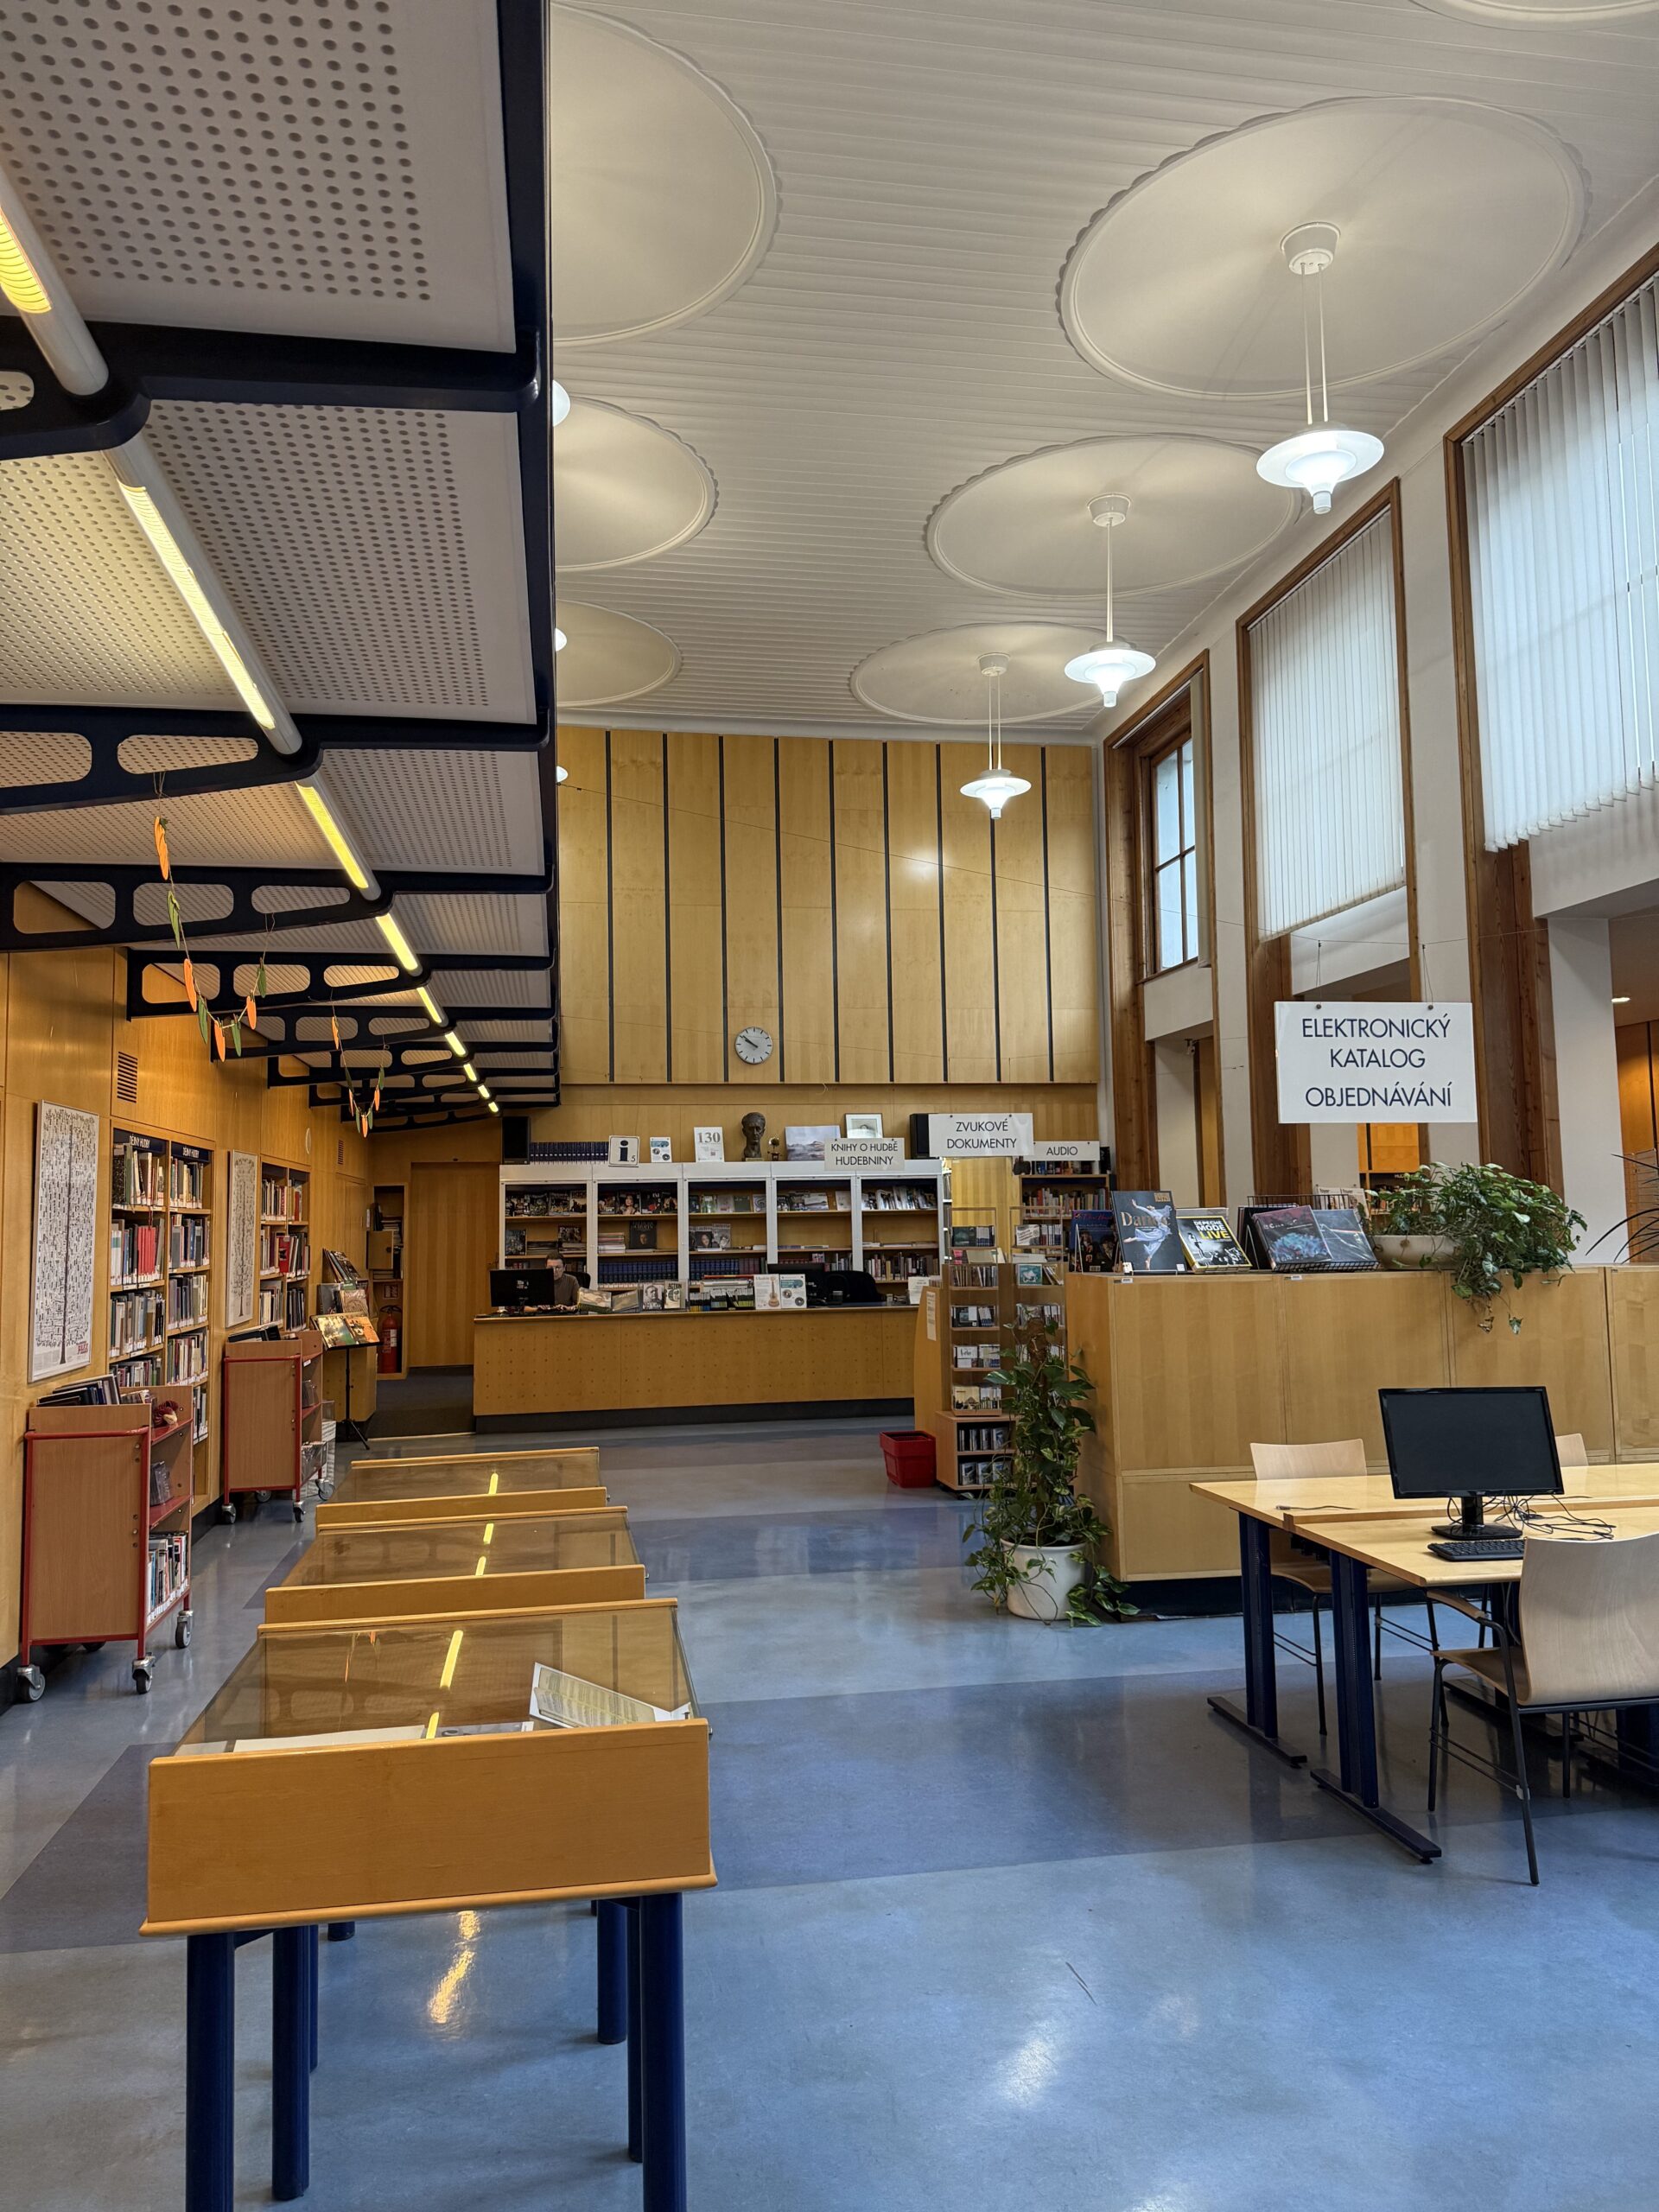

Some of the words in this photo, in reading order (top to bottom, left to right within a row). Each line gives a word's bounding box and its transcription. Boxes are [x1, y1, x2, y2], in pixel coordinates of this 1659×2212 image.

[1302, 1013, 1451, 1039] ELEKTRONICKÝ
[1330, 1048, 1426, 1068] KATALOG
[1305, 1082, 1452, 1108] OBJEDNÁVÁNÍ
[956, 1118, 1008, 1132] ZVUKOVÉ
[698, 1132, 721, 1143] 130
[830, 1143, 857, 1152] KNIHY
[859, 1142, 868, 1152] O
[869, 1141, 898, 1152] HUDBĚ
[947, 1138, 1017, 1149] DOKUMENTY
[1046, 1146, 1078, 1156] AUDIO
[836, 1155, 893, 1166] HUDEBNINY
[1199, 1230, 1231, 1239] LIVE
